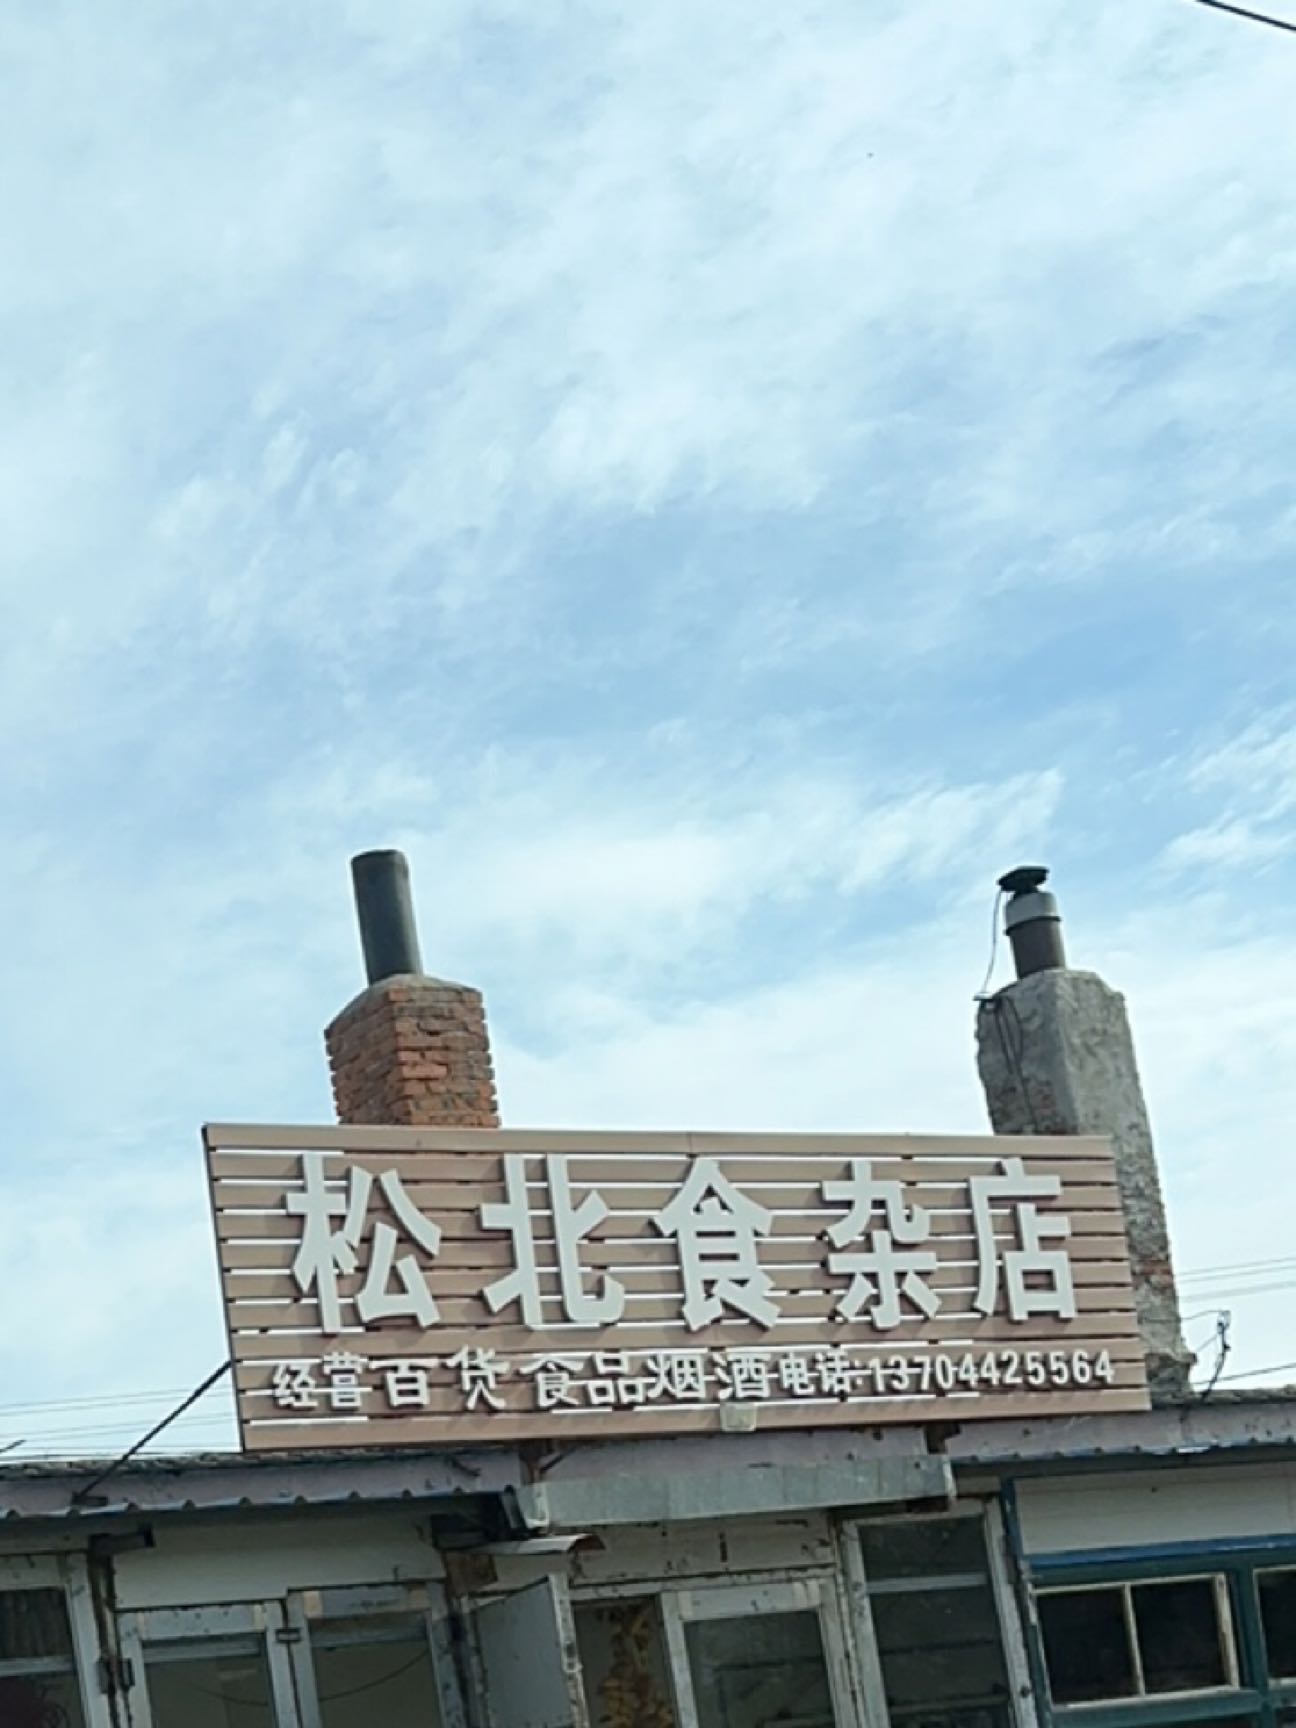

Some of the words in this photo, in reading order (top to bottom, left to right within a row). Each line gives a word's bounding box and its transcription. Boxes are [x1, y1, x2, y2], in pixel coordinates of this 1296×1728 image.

[285, 1150, 1079, 1333] 松北食杂店
